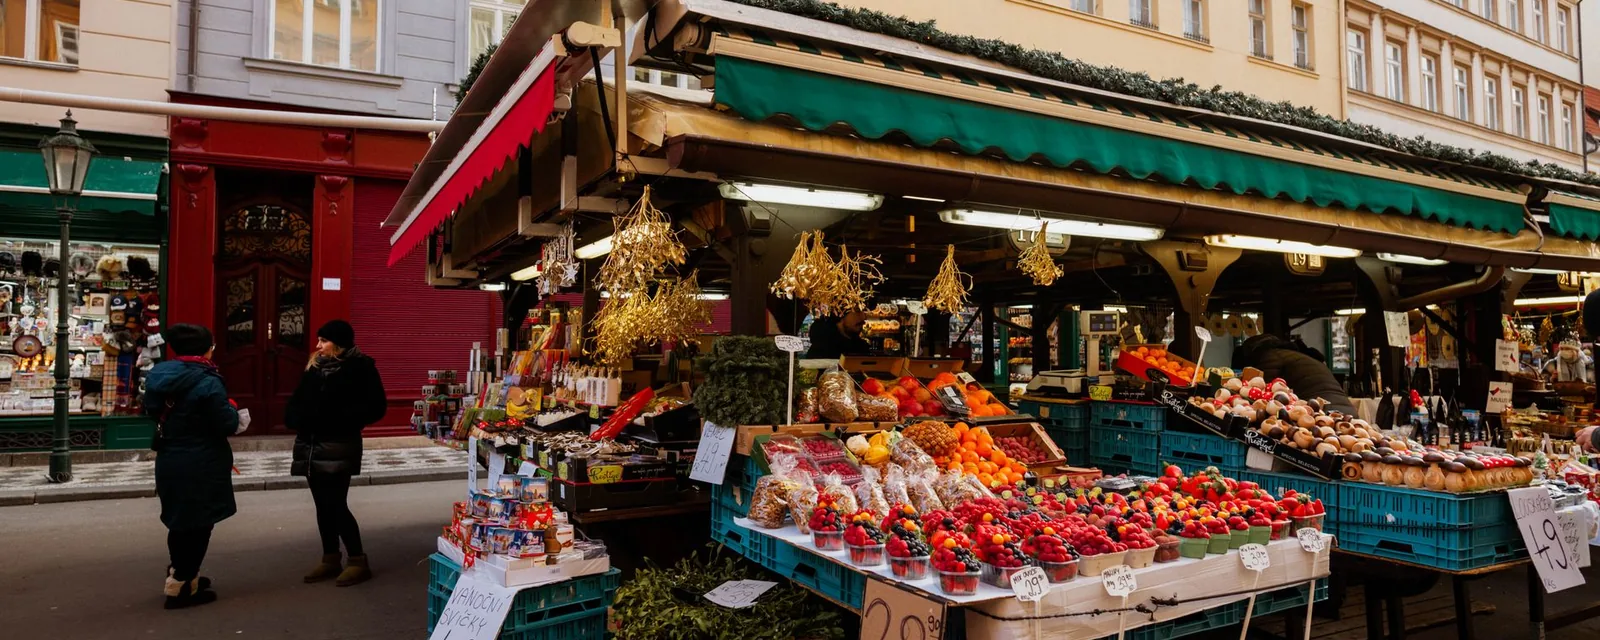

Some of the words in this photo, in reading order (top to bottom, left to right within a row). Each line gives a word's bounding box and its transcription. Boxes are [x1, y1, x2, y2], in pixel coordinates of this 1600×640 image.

[1292, 252, 1306, 266] 19
[1161, 391, 1186, 414] Prestige
[1244, 429, 1275, 454] Prestige
[1280, 452, 1297, 463] SPECIAL
[1297, 458, 1320, 472] SELECTION
[588, 467, 620, 484] Prestige
[451, 585, 512, 613] VÁNOČNÍ
[439, 607, 488, 637] SVÍČKY
